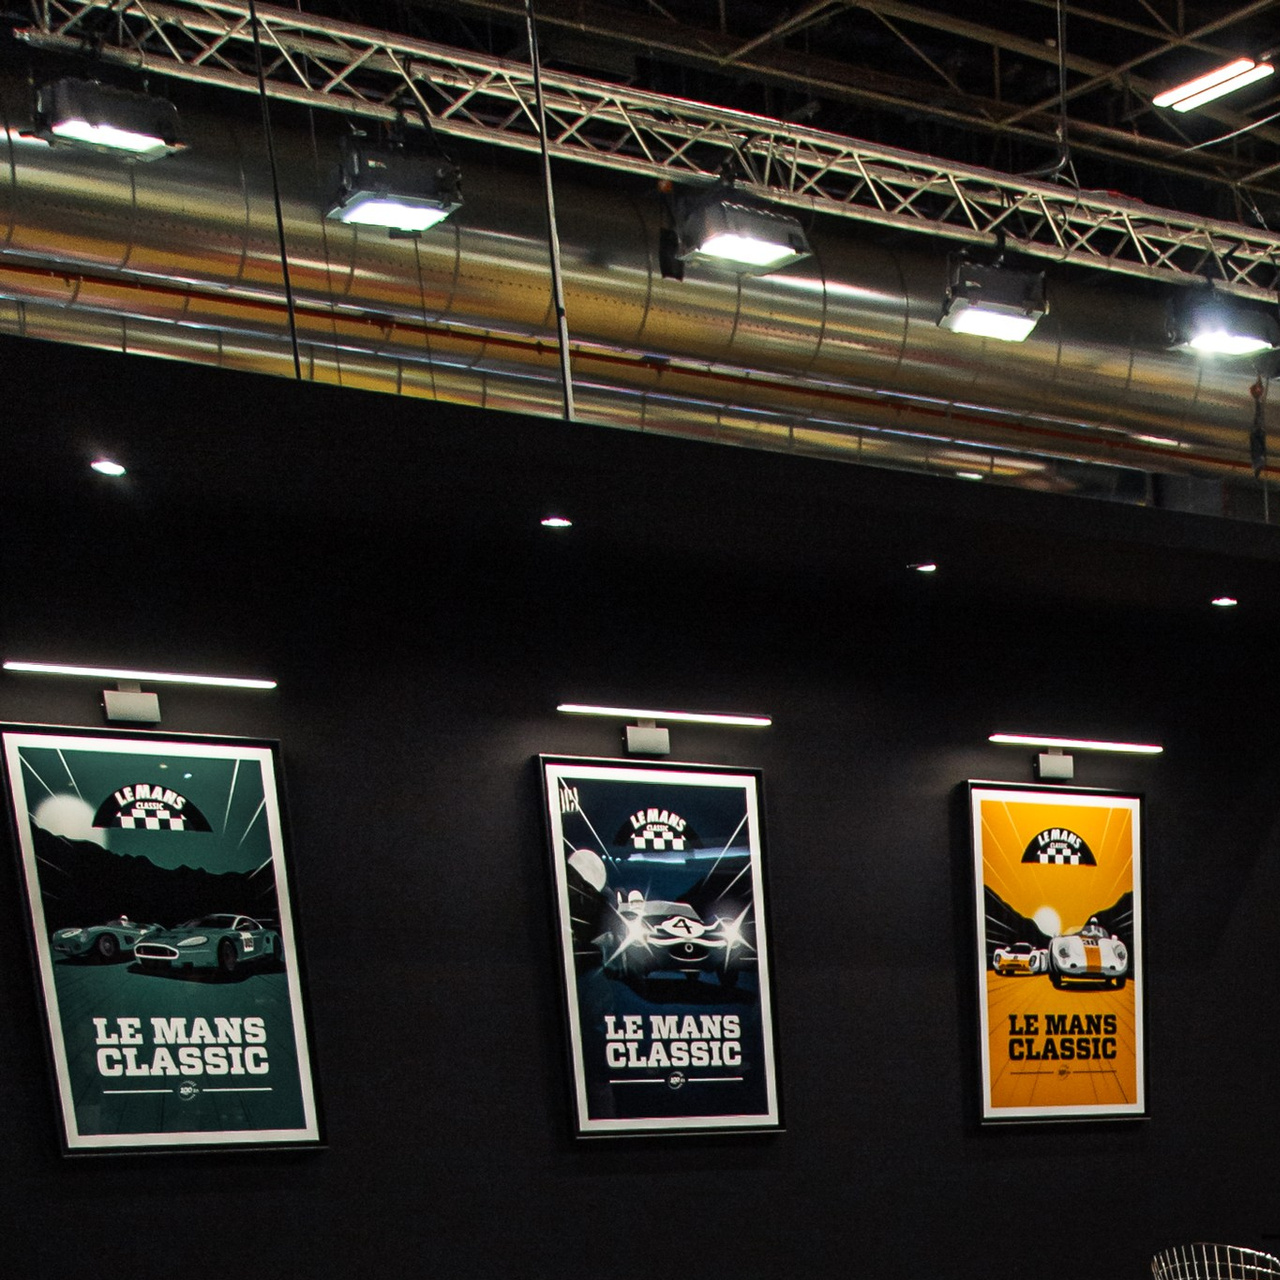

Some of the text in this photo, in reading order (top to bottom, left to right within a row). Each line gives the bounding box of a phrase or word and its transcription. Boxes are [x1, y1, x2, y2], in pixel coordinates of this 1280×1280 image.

[114, 784, 187, 810] LE MANS
[135, 801, 165, 810] CLASSIC
[629, 808, 687, 833] LE MANS
[1037, 829, 1082, 849] LE MANS
[672, 919, 693, 934] 4
[93, 1017, 267, 1045] LE MANS
[604, 1014, 741, 1040] LE MANS
[1008, 1014, 1117, 1035] LE MANS
[97, 1046, 269, 1077] CLASSIC
[606, 1040, 742, 1068] CLASSIC
[1008, 1037, 1117, 1061] CLASSIC
